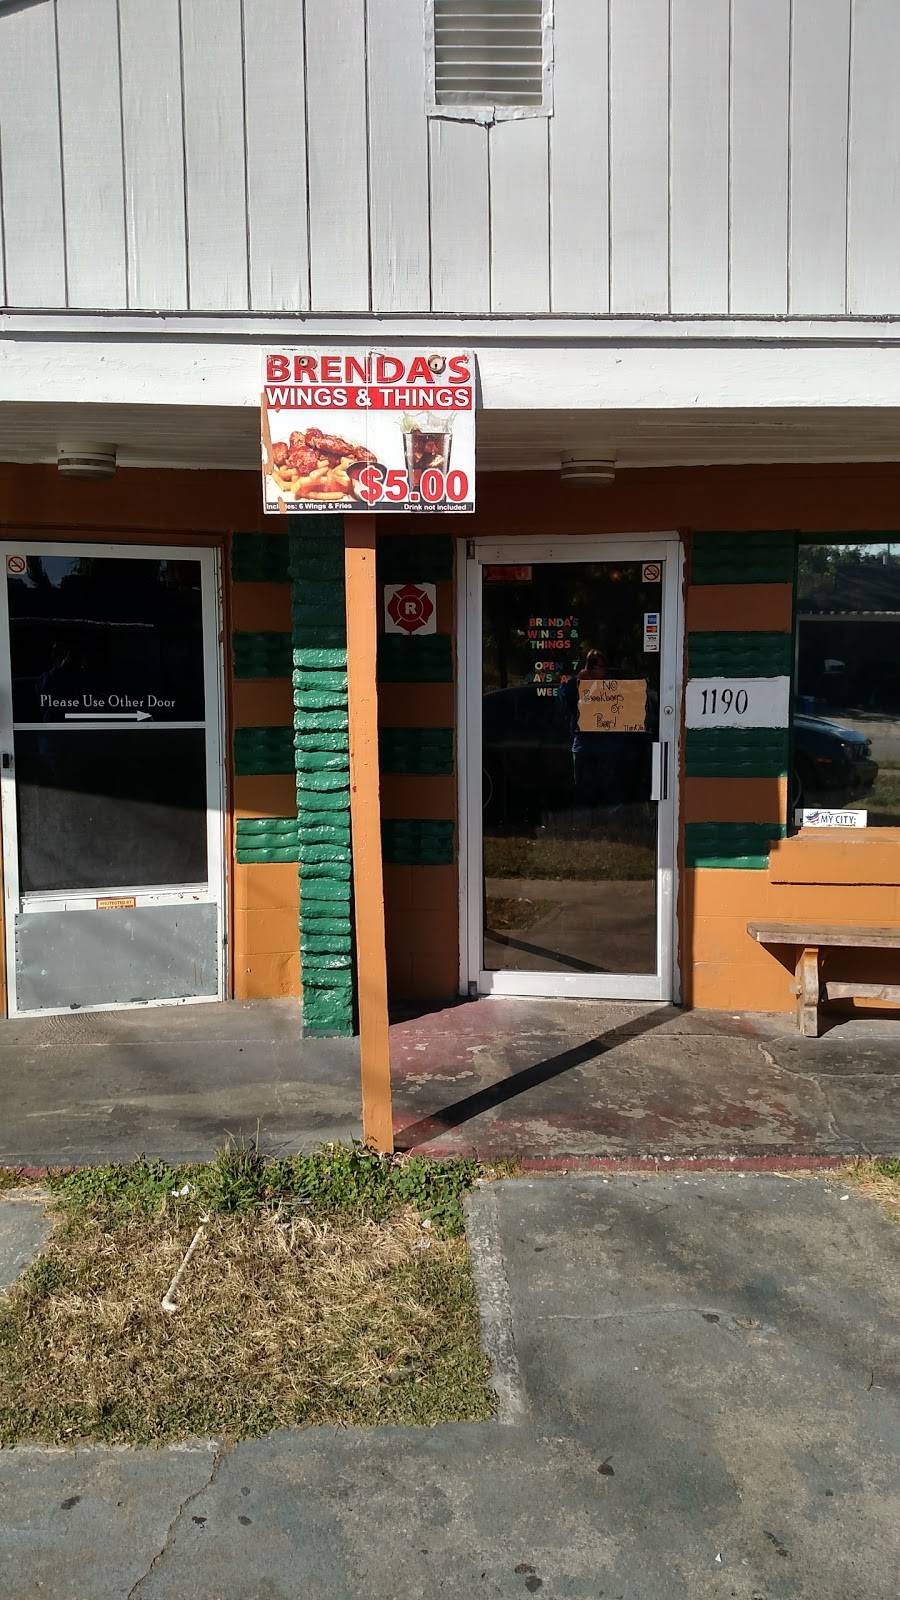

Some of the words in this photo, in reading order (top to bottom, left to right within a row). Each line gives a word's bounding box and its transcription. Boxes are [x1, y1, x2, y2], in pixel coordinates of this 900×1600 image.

[266, 354, 471, 384] BRENDAS
[266, 387, 348, 406] WINGS
[355, 389, 372, 406] &
[379, 387, 470, 407] THINGS
[359, 465, 469, 505] $5.00
[304, 503, 327, 511] Wings
[405, 602, 417, 615] R
[528, 616, 578, 627] BRENDA'S
[528, 629, 564, 639] WINGS
[570, 629, 579, 638] &
[530, 640, 571, 649] THINGS
[534, 661, 562, 671] OPEN
[571, 661, 579, 671] 7
[560, 674, 569, 683] A
[603, 681, 618, 691] NO
[536, 687, 566, 697] WEEK
[40, 694, 79, 707] Please
[83, 694, 105, 707] Use
[108, 694, 144, 707] Other
[147, 694, 176, 707] Door
[702, 688, 748, 715] 1190
[820, 815, 834, 824] MY
